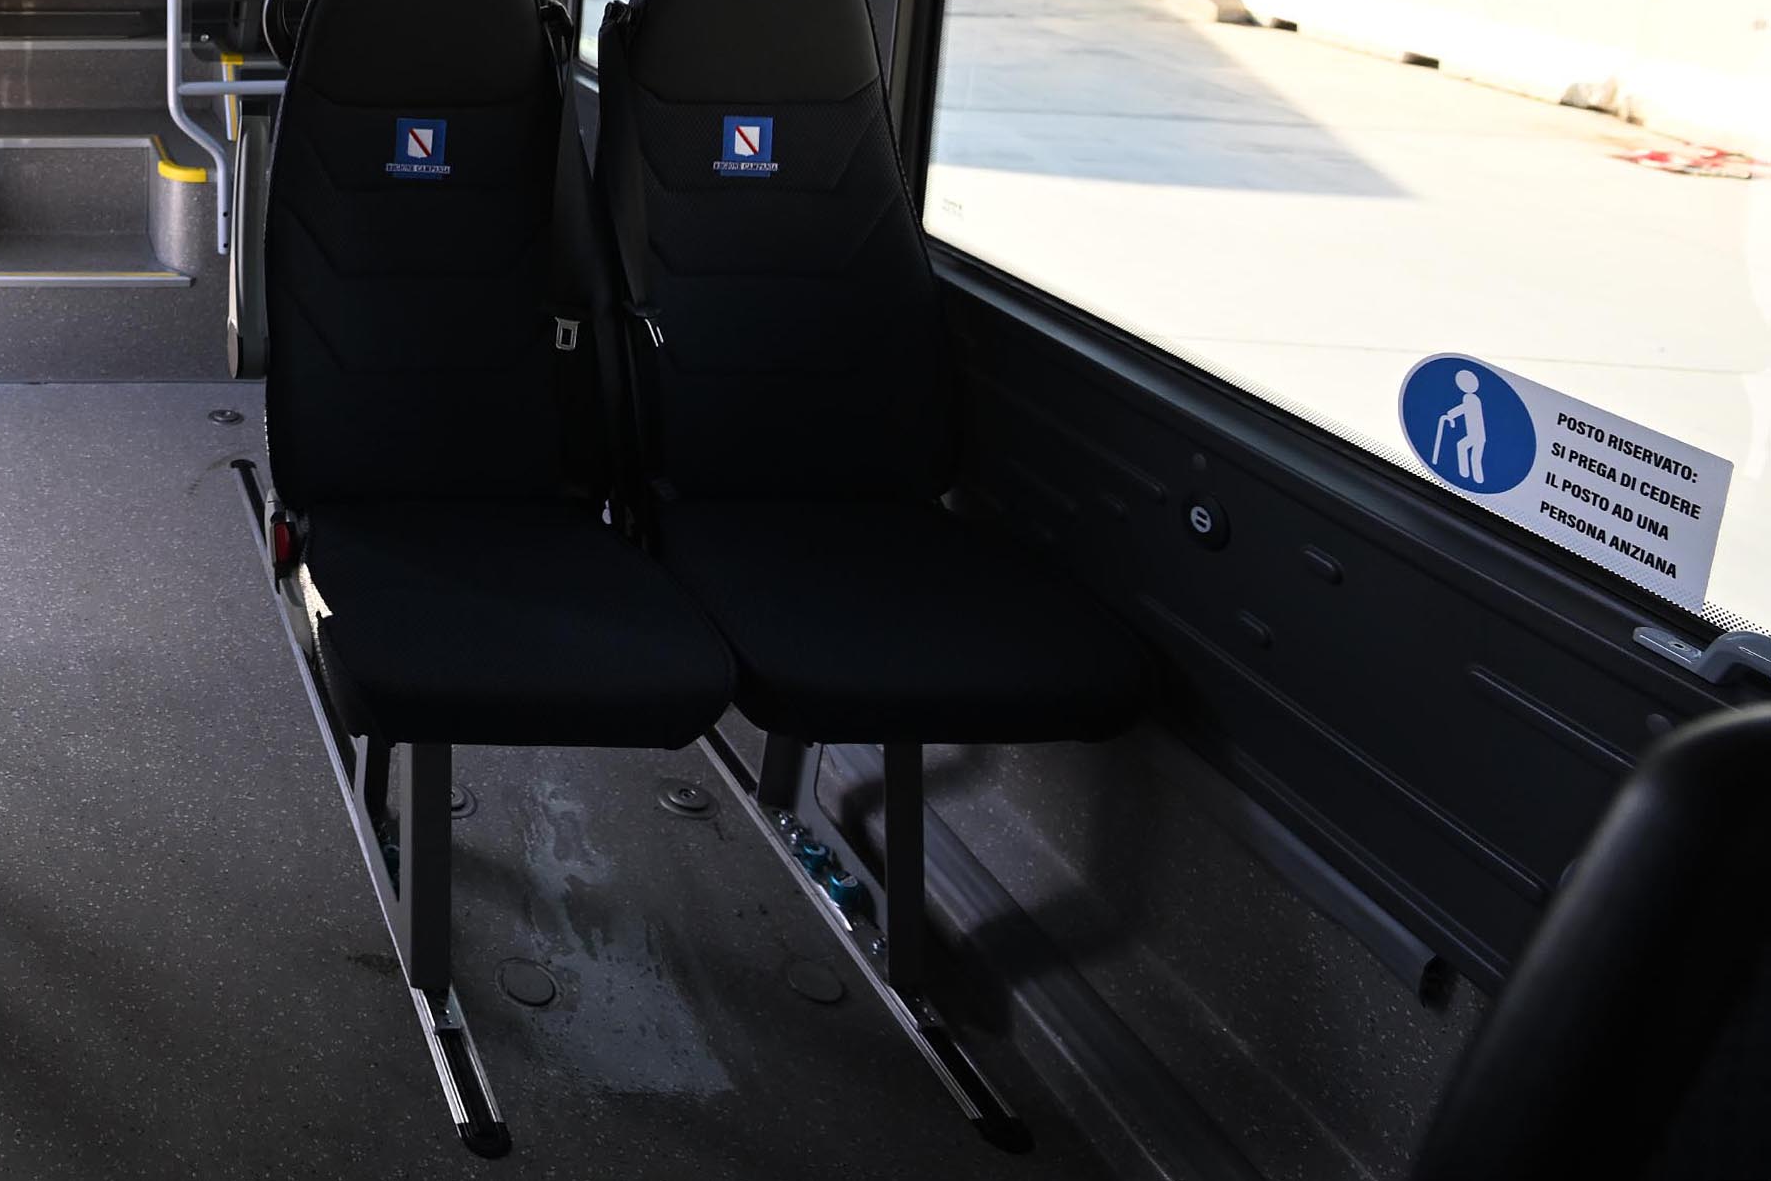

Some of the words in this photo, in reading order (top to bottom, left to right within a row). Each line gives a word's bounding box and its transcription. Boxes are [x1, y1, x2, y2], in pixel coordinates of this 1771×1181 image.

[1551, 442, 1566, 459] SI
[1568, 450, 1617, 483] PREGA
[1619, 473, 1637, 491] DI
[1640, 481, 1702, 520] CEDERE
[1557, 412, 1605, 444] POSTO
[1607, 433, 1698, 484] RISERVATO:
[1540, 500, 1606, 544] PERSONA
[1609, 535, 1677, 579] ANZIANA
[1545, 471, 1558, 489] IL
[1561, 479, 1610, 512] POSTO
[1611, 503, 1633, 522] AD
[1636, 514, 1669, 541] UNA
